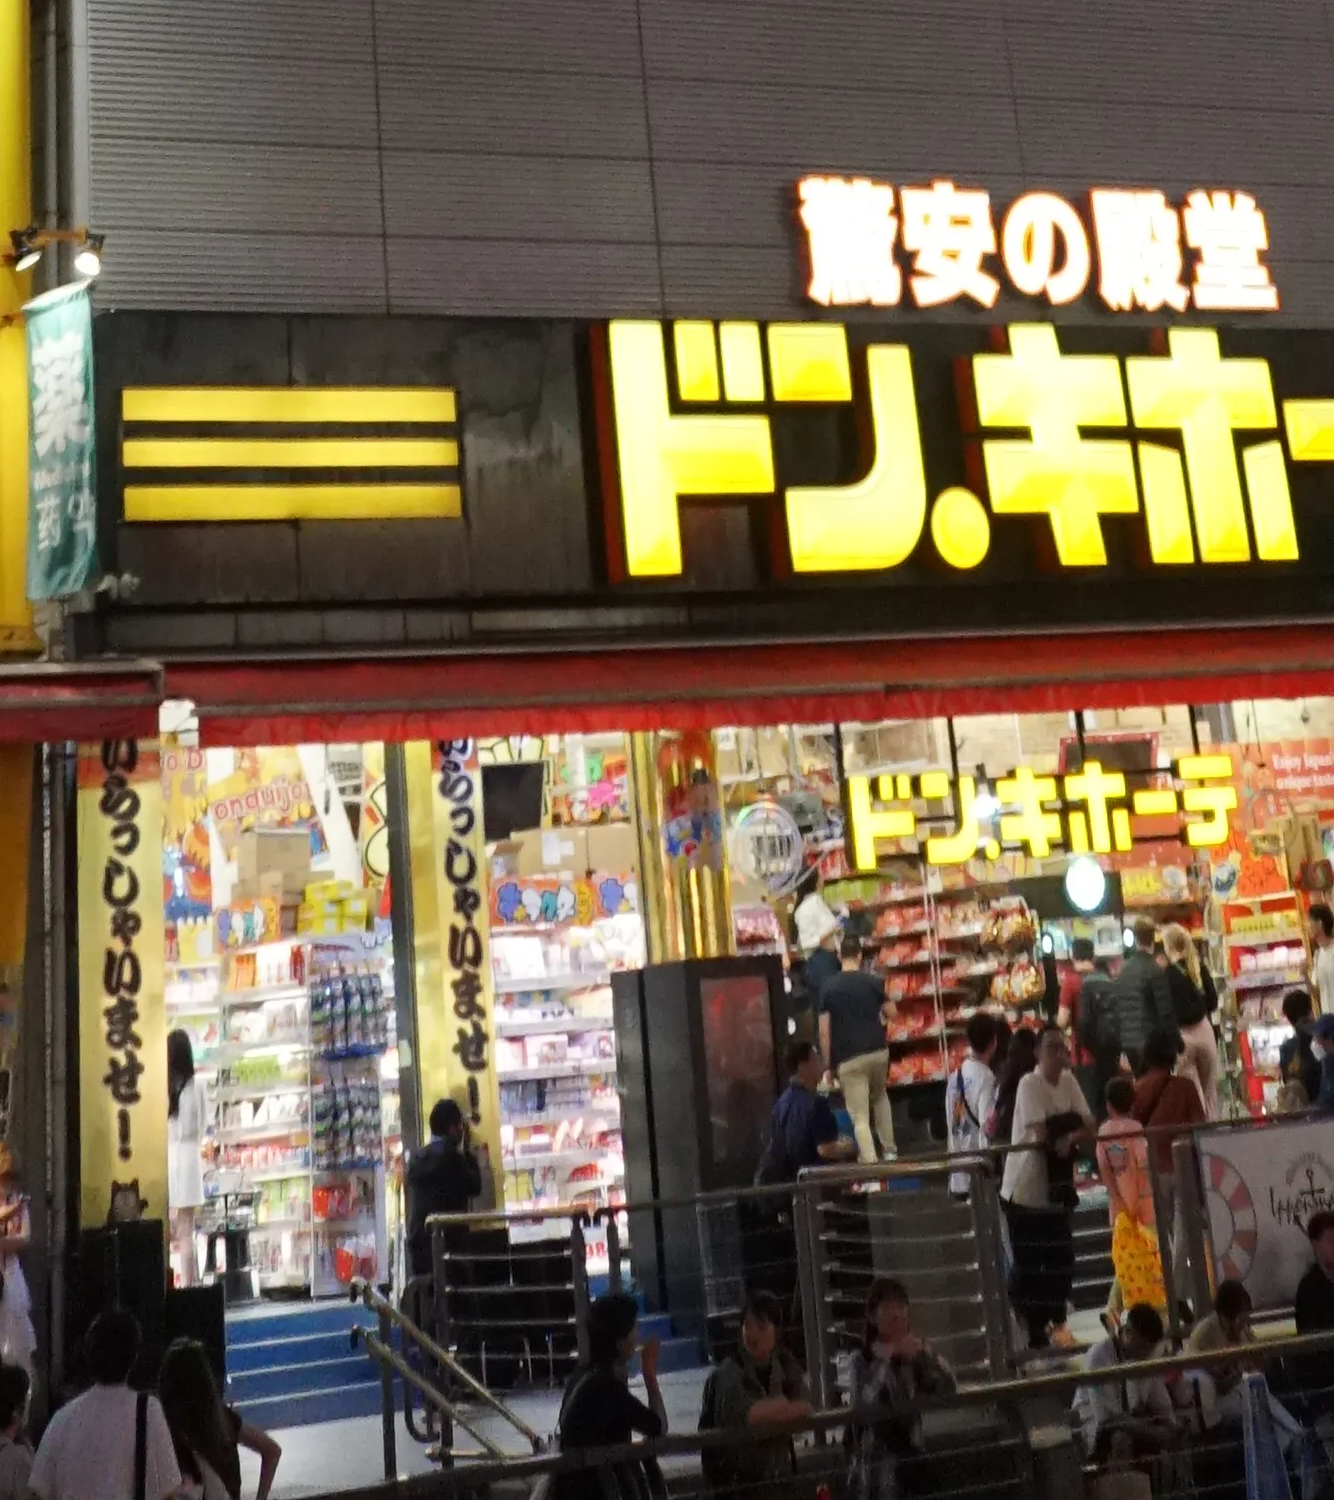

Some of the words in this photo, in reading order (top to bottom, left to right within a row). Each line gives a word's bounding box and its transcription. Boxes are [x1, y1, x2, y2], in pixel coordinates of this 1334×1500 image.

[796, 173, 1280, 313] 驚安の殿堂
